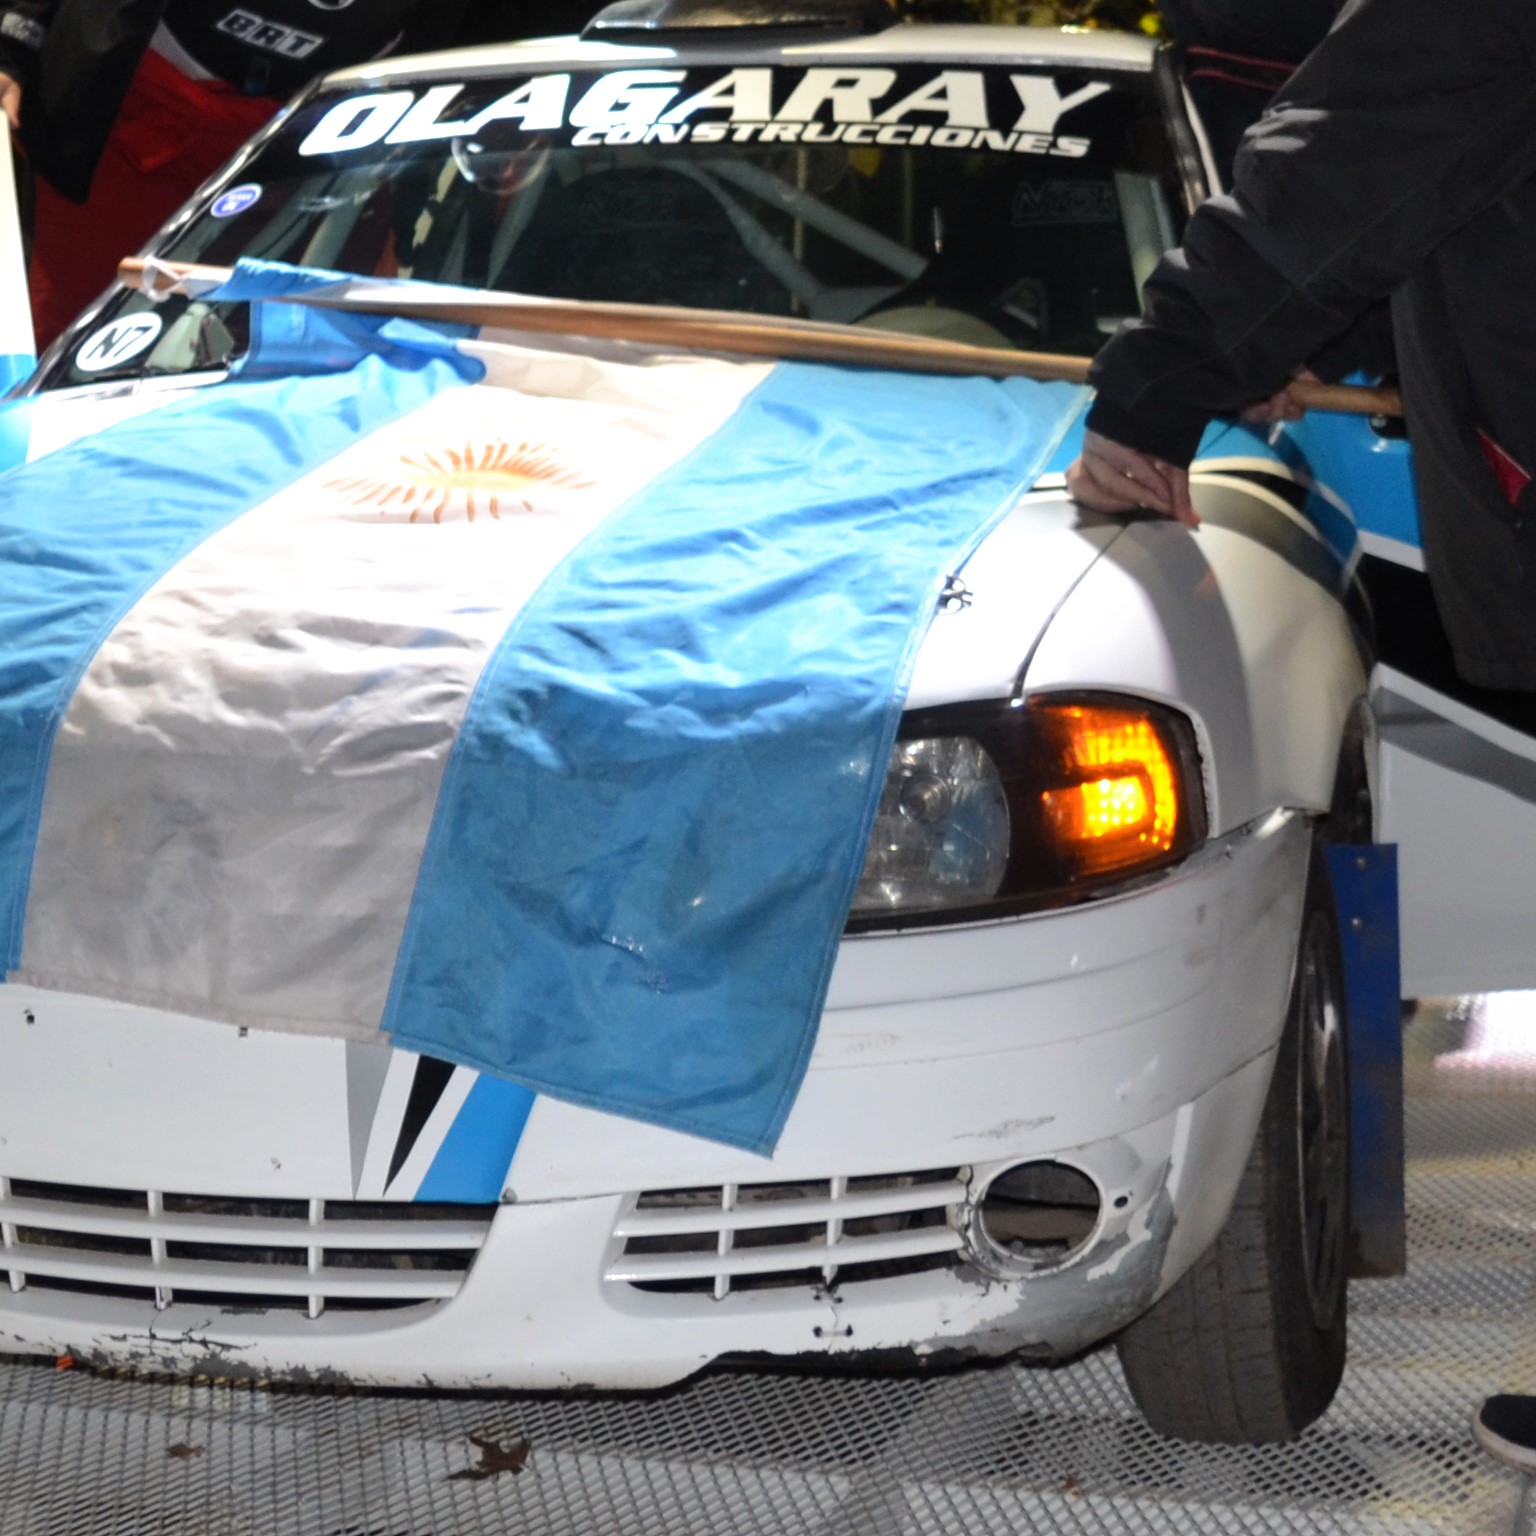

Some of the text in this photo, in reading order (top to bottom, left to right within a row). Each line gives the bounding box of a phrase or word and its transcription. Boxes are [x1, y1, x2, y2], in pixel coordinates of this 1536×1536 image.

[220, 11, 319, 56] BRT
[298, 67, 1112, 156] OLAGARAY
[571, 121, 1091, 158] CONSTRUCCIONES
[85, 325, 154, 360] N7
